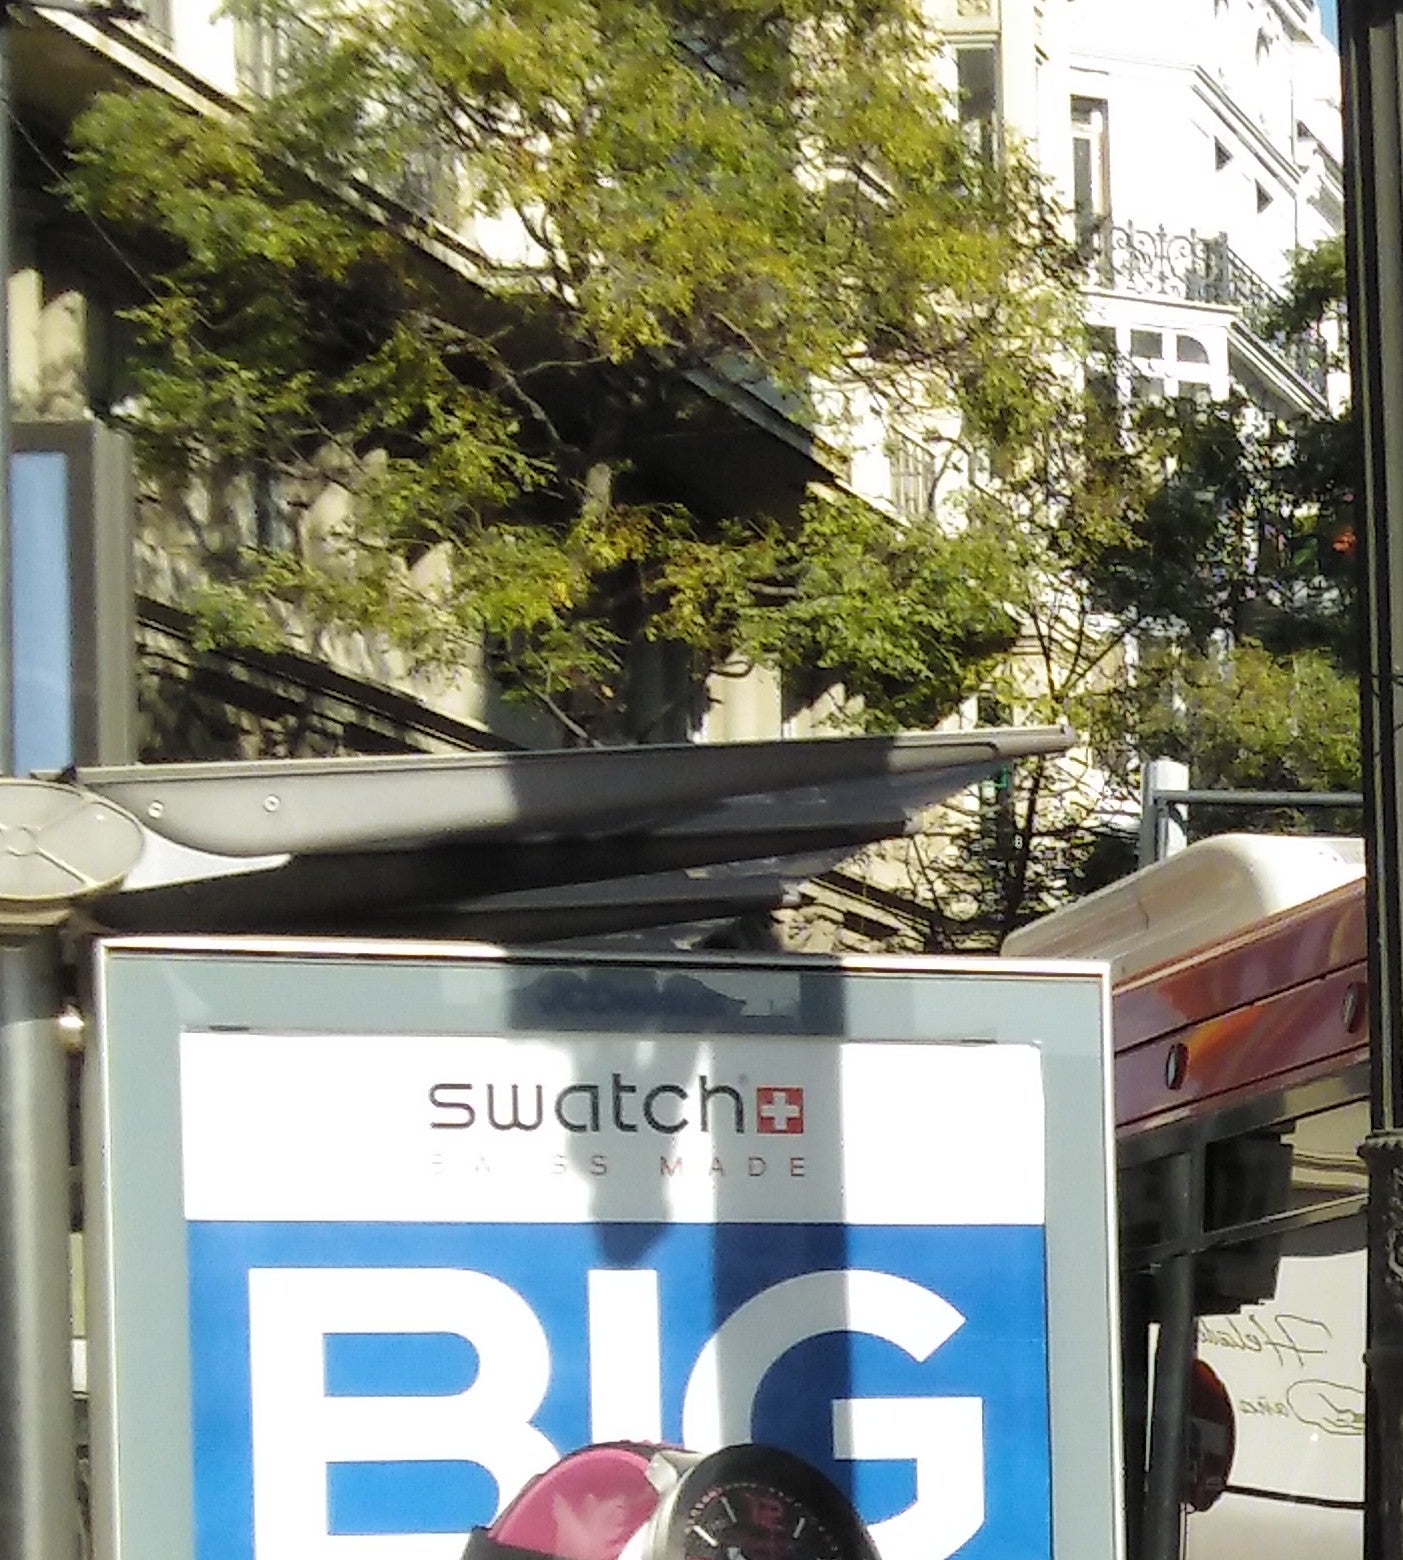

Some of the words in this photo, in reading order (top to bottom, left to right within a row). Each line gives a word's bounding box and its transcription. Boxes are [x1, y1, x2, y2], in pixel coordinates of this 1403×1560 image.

[428, 1073, 745, 1133] swatch
[431, 1153, 608, 1177] SWSS
[660, 1156, 807, 1177] MADE
